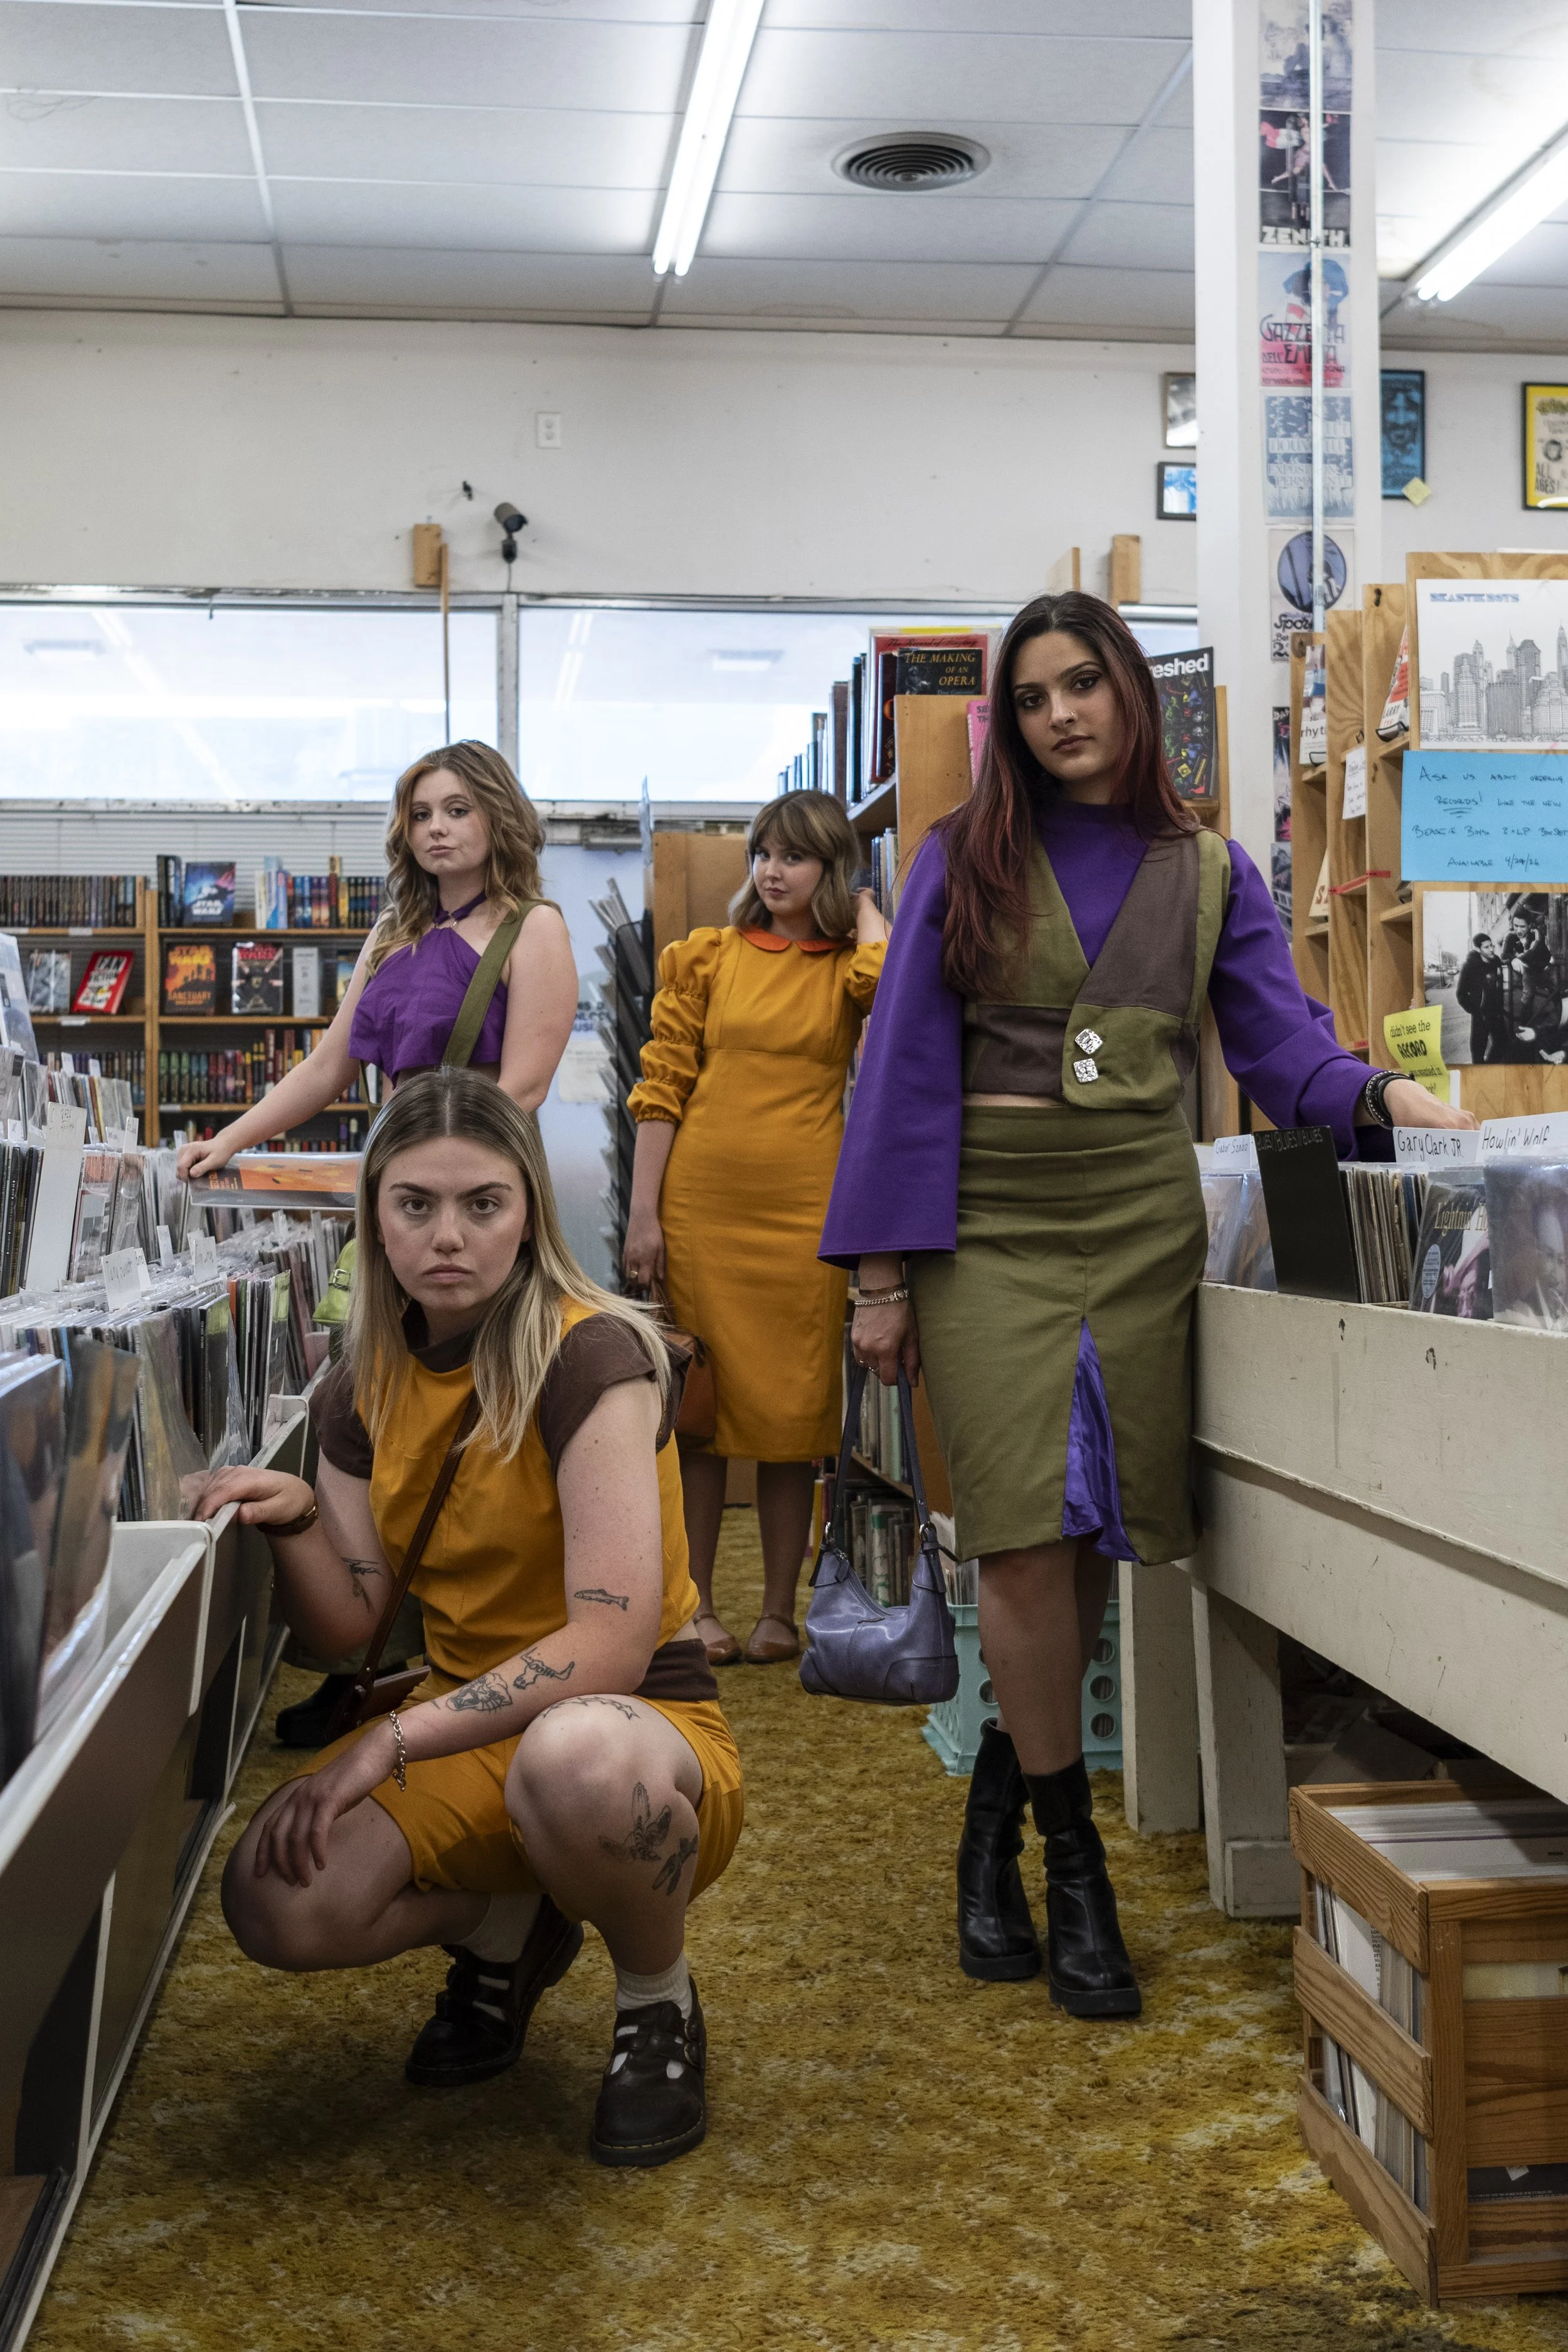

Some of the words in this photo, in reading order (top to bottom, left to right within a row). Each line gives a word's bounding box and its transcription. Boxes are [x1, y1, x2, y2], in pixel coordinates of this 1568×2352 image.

[1261, 226, 1350, 248] ZENTH.
[1259, 314, 1344, 343] GAZZETA
[1430, 593, 1485, 602] BEASTIE
[1486, 593, 1519, 602] BOYS
[905, 653, 926, 663] THE
[930, 653, 976, 662] MAKING
[939, 676, 975, 686] OPERA
[1301, 726, 1326, 739] rhyt
[1390, 1024, 1406, 1037] didn't
[1406, 1025, 1417, 1035] see
[1418, 1020, 1431, 1032] the
[1397, 1039, 1428, 1059] RECORD
[1397, 1130, 1425, 1162] Gary
[1424, 1133, 1449, 1157] Clark
[1481, 1126, 1520, 1150] Howlin'
[1523, 1125, 1550, 1146] Wolf
